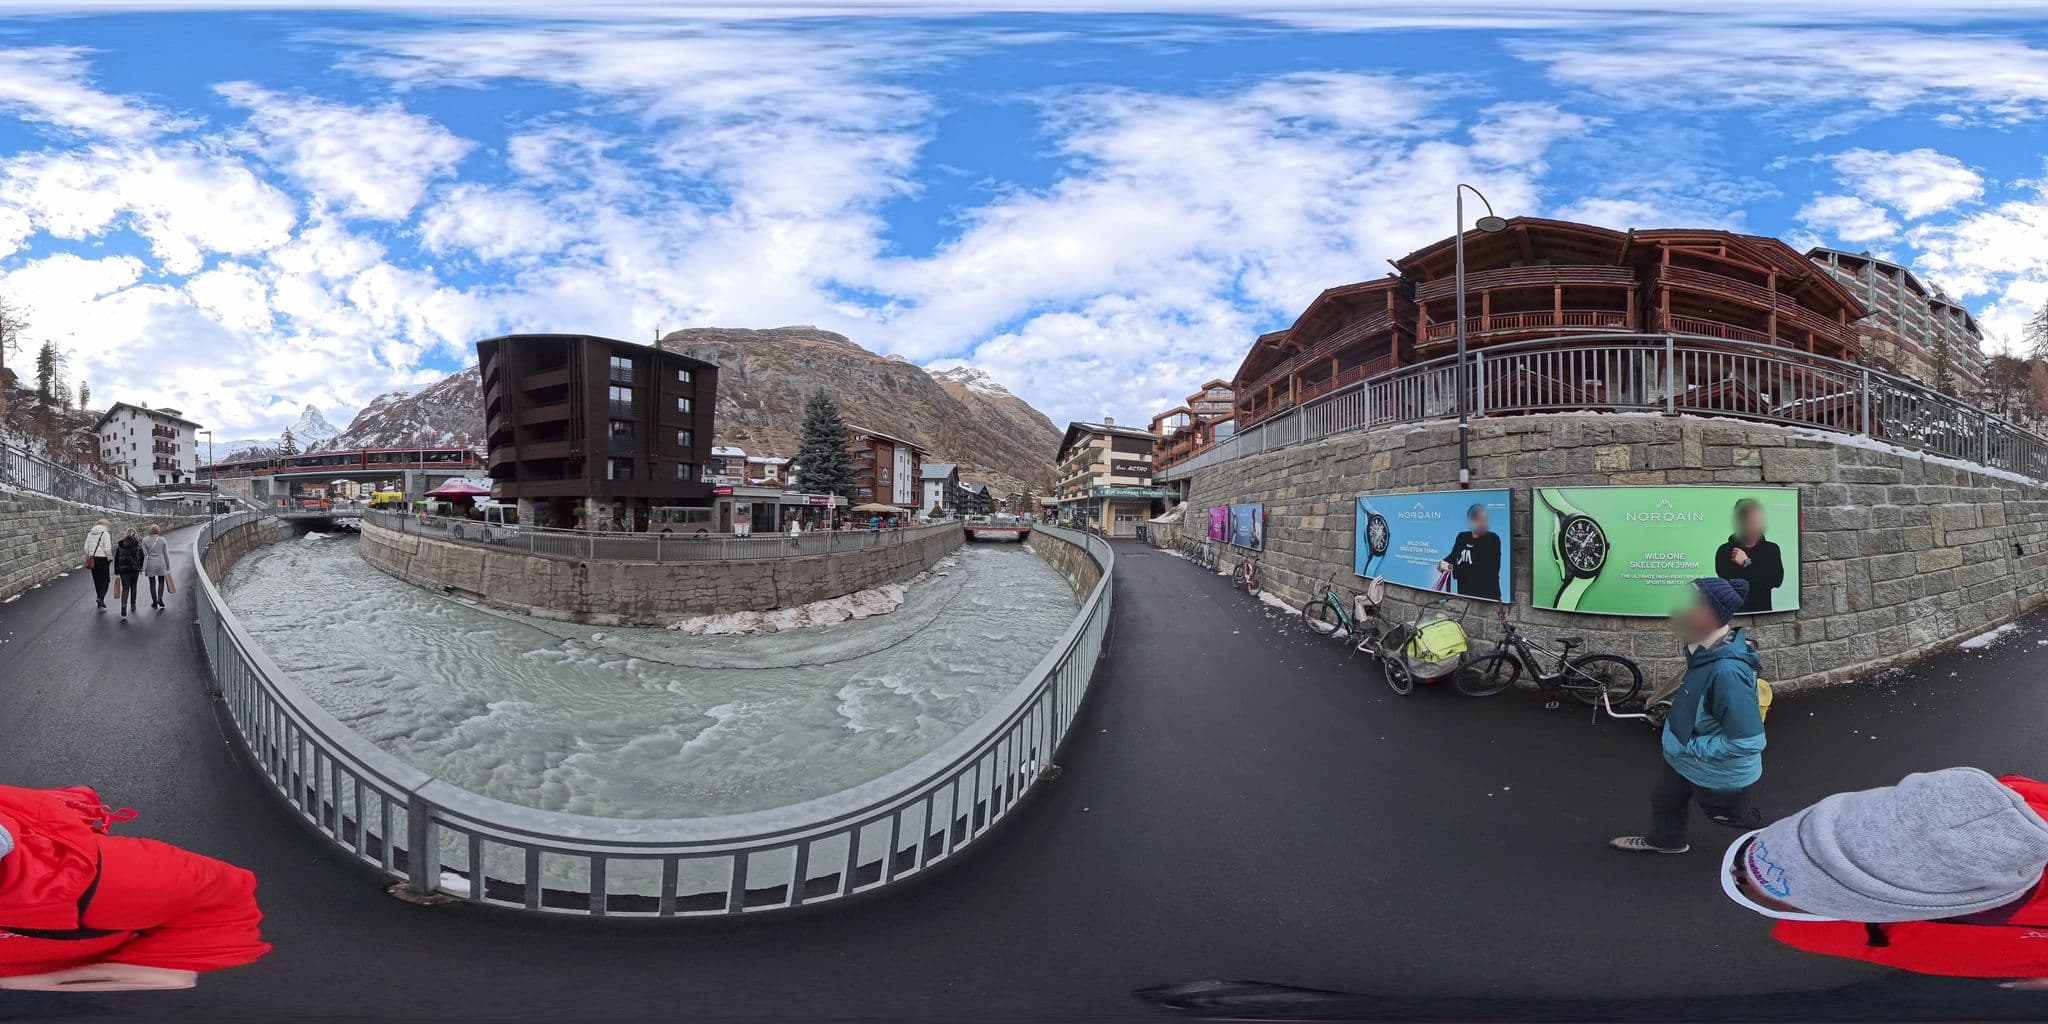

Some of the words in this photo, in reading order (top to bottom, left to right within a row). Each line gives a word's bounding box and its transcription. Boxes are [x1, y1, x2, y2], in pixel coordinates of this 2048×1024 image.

[1626, 512, 1703, 521] NORQAIN
[1645, 552, 1666, 560] WILD
[1667, 552, 1686, 560] ONE
[1630, 561, 1674, 569] SKELETON
[1675, 561, 1699, 569] 39MM
